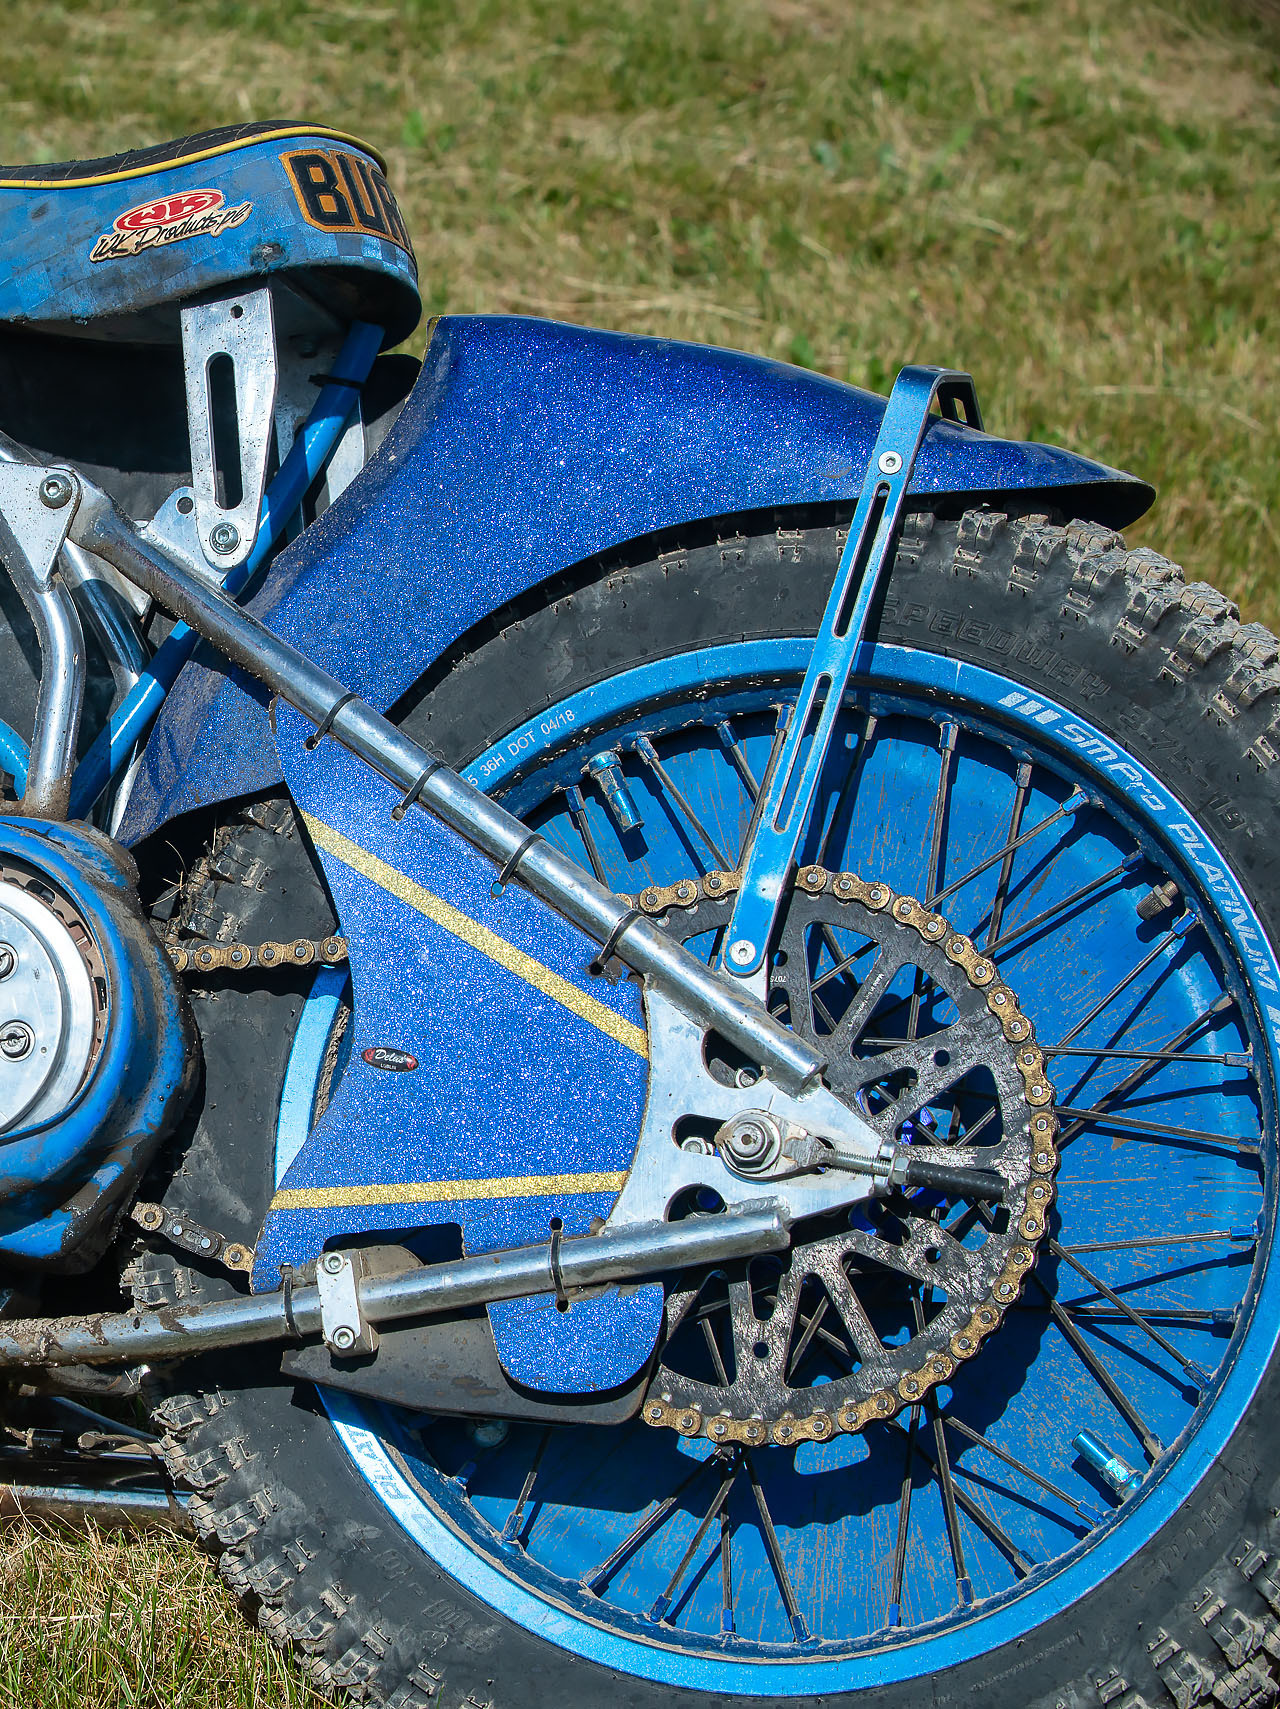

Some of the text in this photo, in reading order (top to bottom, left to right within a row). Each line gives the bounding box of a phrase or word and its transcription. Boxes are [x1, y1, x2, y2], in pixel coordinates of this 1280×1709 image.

[880, 597, 1111, 700] SPEEDWAY
[480, 753, 506, 776] 36H
[507, 730, 538, 757] DOT
[540, 709, 575, 735] 04/18
